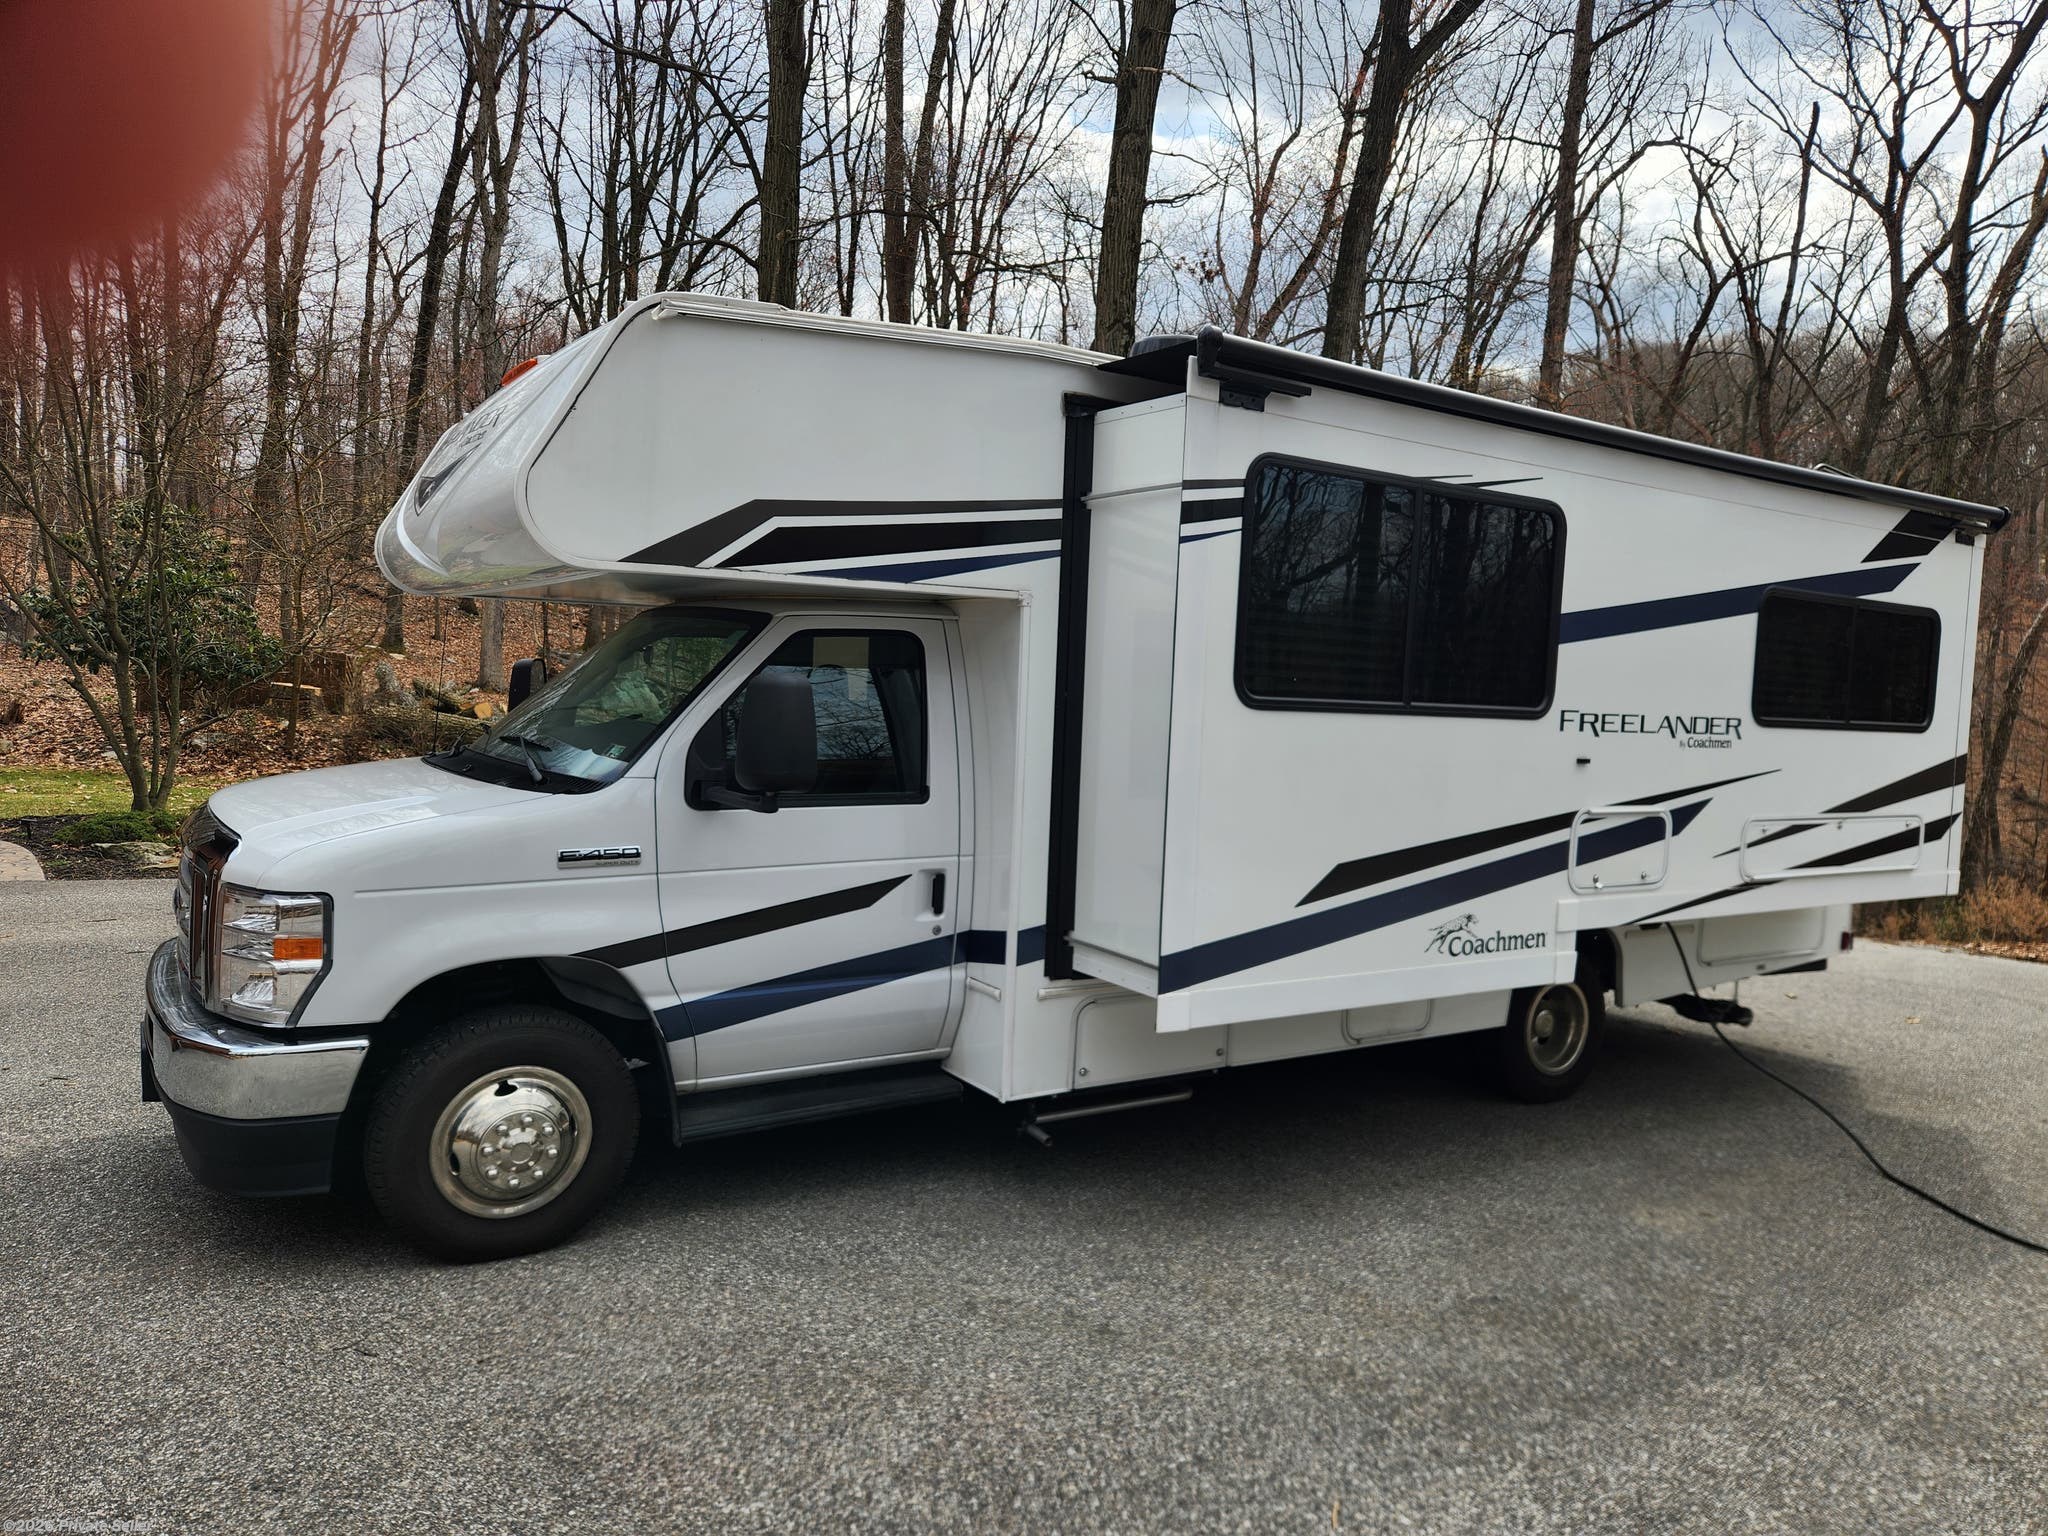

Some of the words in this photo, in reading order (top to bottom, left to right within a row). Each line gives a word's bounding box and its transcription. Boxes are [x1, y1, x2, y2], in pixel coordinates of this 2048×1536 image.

[1559, 709, 1742, 740] FREELANDER
[1687, 736, 1732, 749] Coachmen
[1448, 930, 1546, 957] Coachmen
